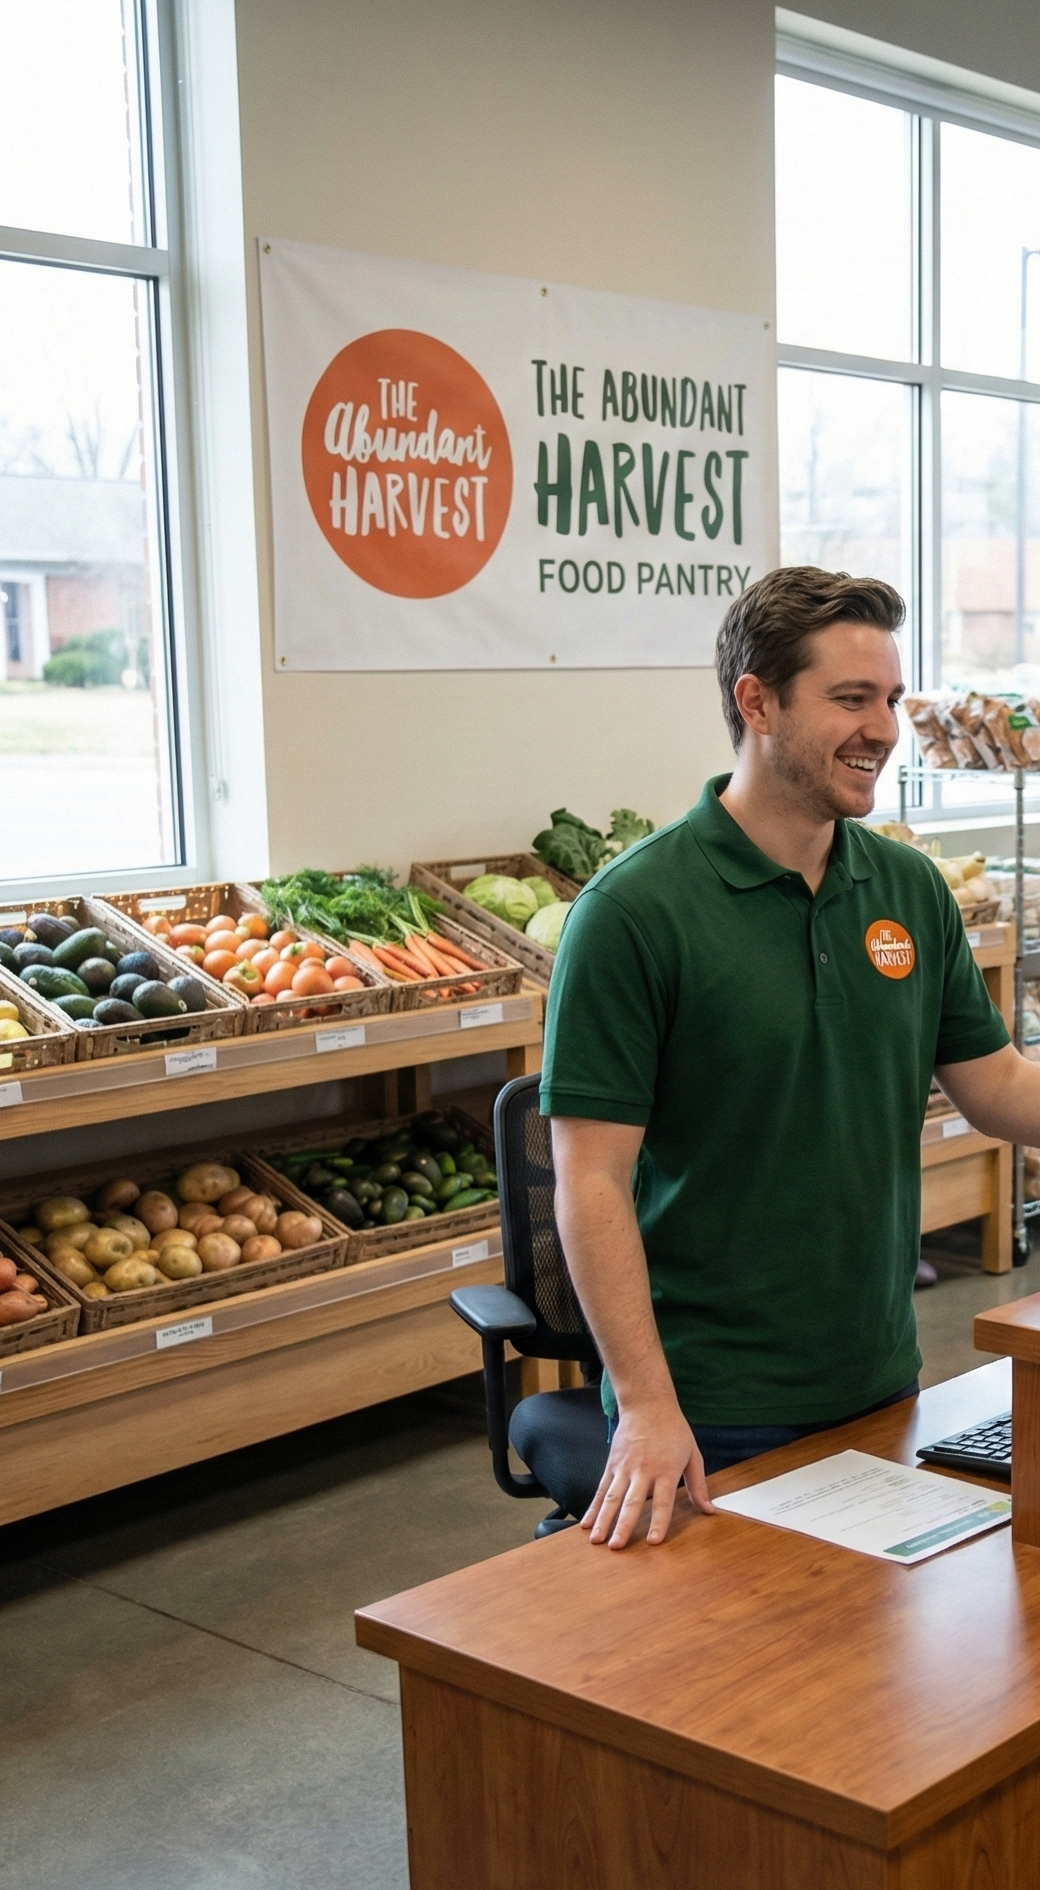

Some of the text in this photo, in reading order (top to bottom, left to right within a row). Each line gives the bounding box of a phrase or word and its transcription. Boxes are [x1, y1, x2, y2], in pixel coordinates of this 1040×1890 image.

[377, 378, 419, 422] THE
[531, 359, 747, 436] THE ABUNDANT
[329, 465, 489, 542] HARVEST
[534, 432, 749, 546] HARVEST
[539, 559, 751, 597] FOOD PANTRY
